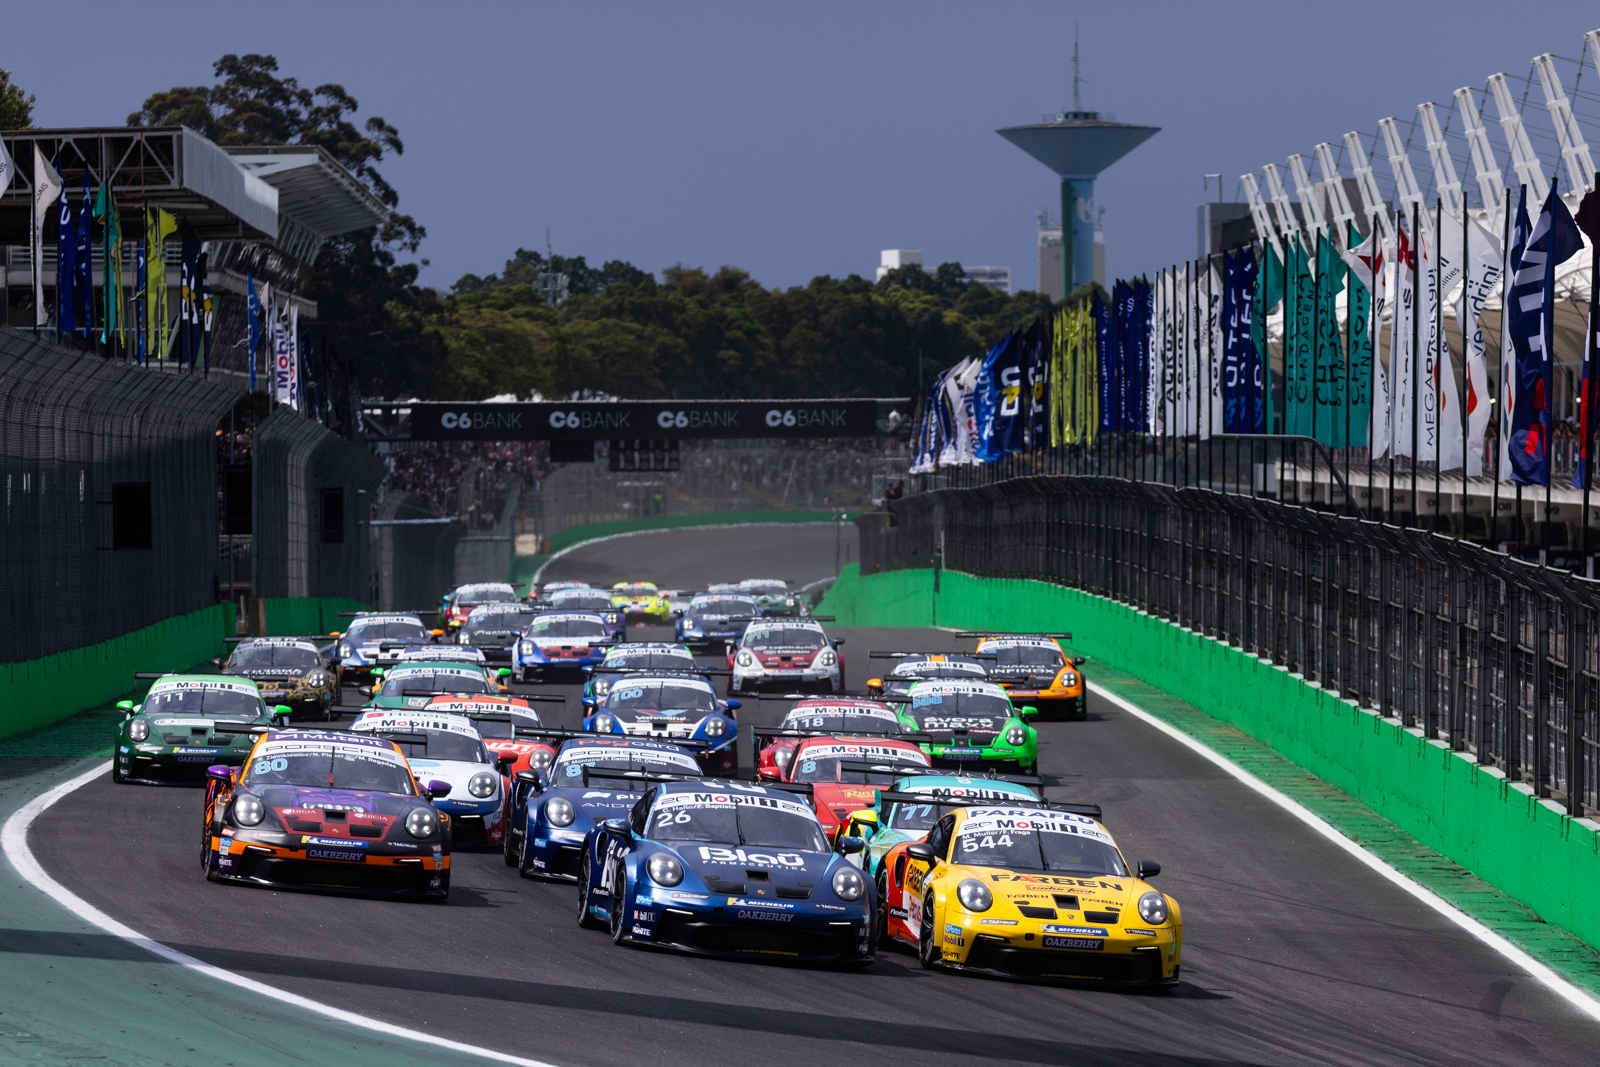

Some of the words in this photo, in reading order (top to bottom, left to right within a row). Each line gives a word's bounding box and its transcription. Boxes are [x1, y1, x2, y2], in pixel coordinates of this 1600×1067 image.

[276, 329, 288, 389] Mobil
[151, 692, 184, 705] 111
[611, 689, 643, 702] 100
[814, 707, 856, 715] Mobil
[381, 719, 430, 728] Mobil
[789, 717, 824, 730] 118
[303, 733, 383, 747] Mutant
[265, 744, 396, 761] PORSCHE
[831, 745, 880, 754] Mobil
[177, 755, 216, 764] OAKBERRY
[570, 749, 690, 766] PORSCHE
[254, 757, 288, 775] 80
[801, 760, 816, 774] 8
[694, 793, 755, 805] Mobil
[901, 803, 933, 820] 77
[970, 809, 1095, 825] PARAFLU
[656, 810, 692, 828] 26
[996, 819, 1057, 831] Mobil
[320, 839, 364, 847] MICHELIN
[962, 834, 1014, 853] 544
[309, 849, 364, 862] OAKBERRY
[990, 874, 1123, 892] FARBEN
[1006, 892, 1049, 900] FARBEN
[747, 901, 795, 909] MICHELIN
[633, 909, 648, 921] Mobil
[737, 909, 795, 923] OAKBERRY
[1058, 926, 1103, 935] MICHELIN
[944, 934, 957, 946] Mobil
[1045, 937, 1102, 949] OAKBERRY
